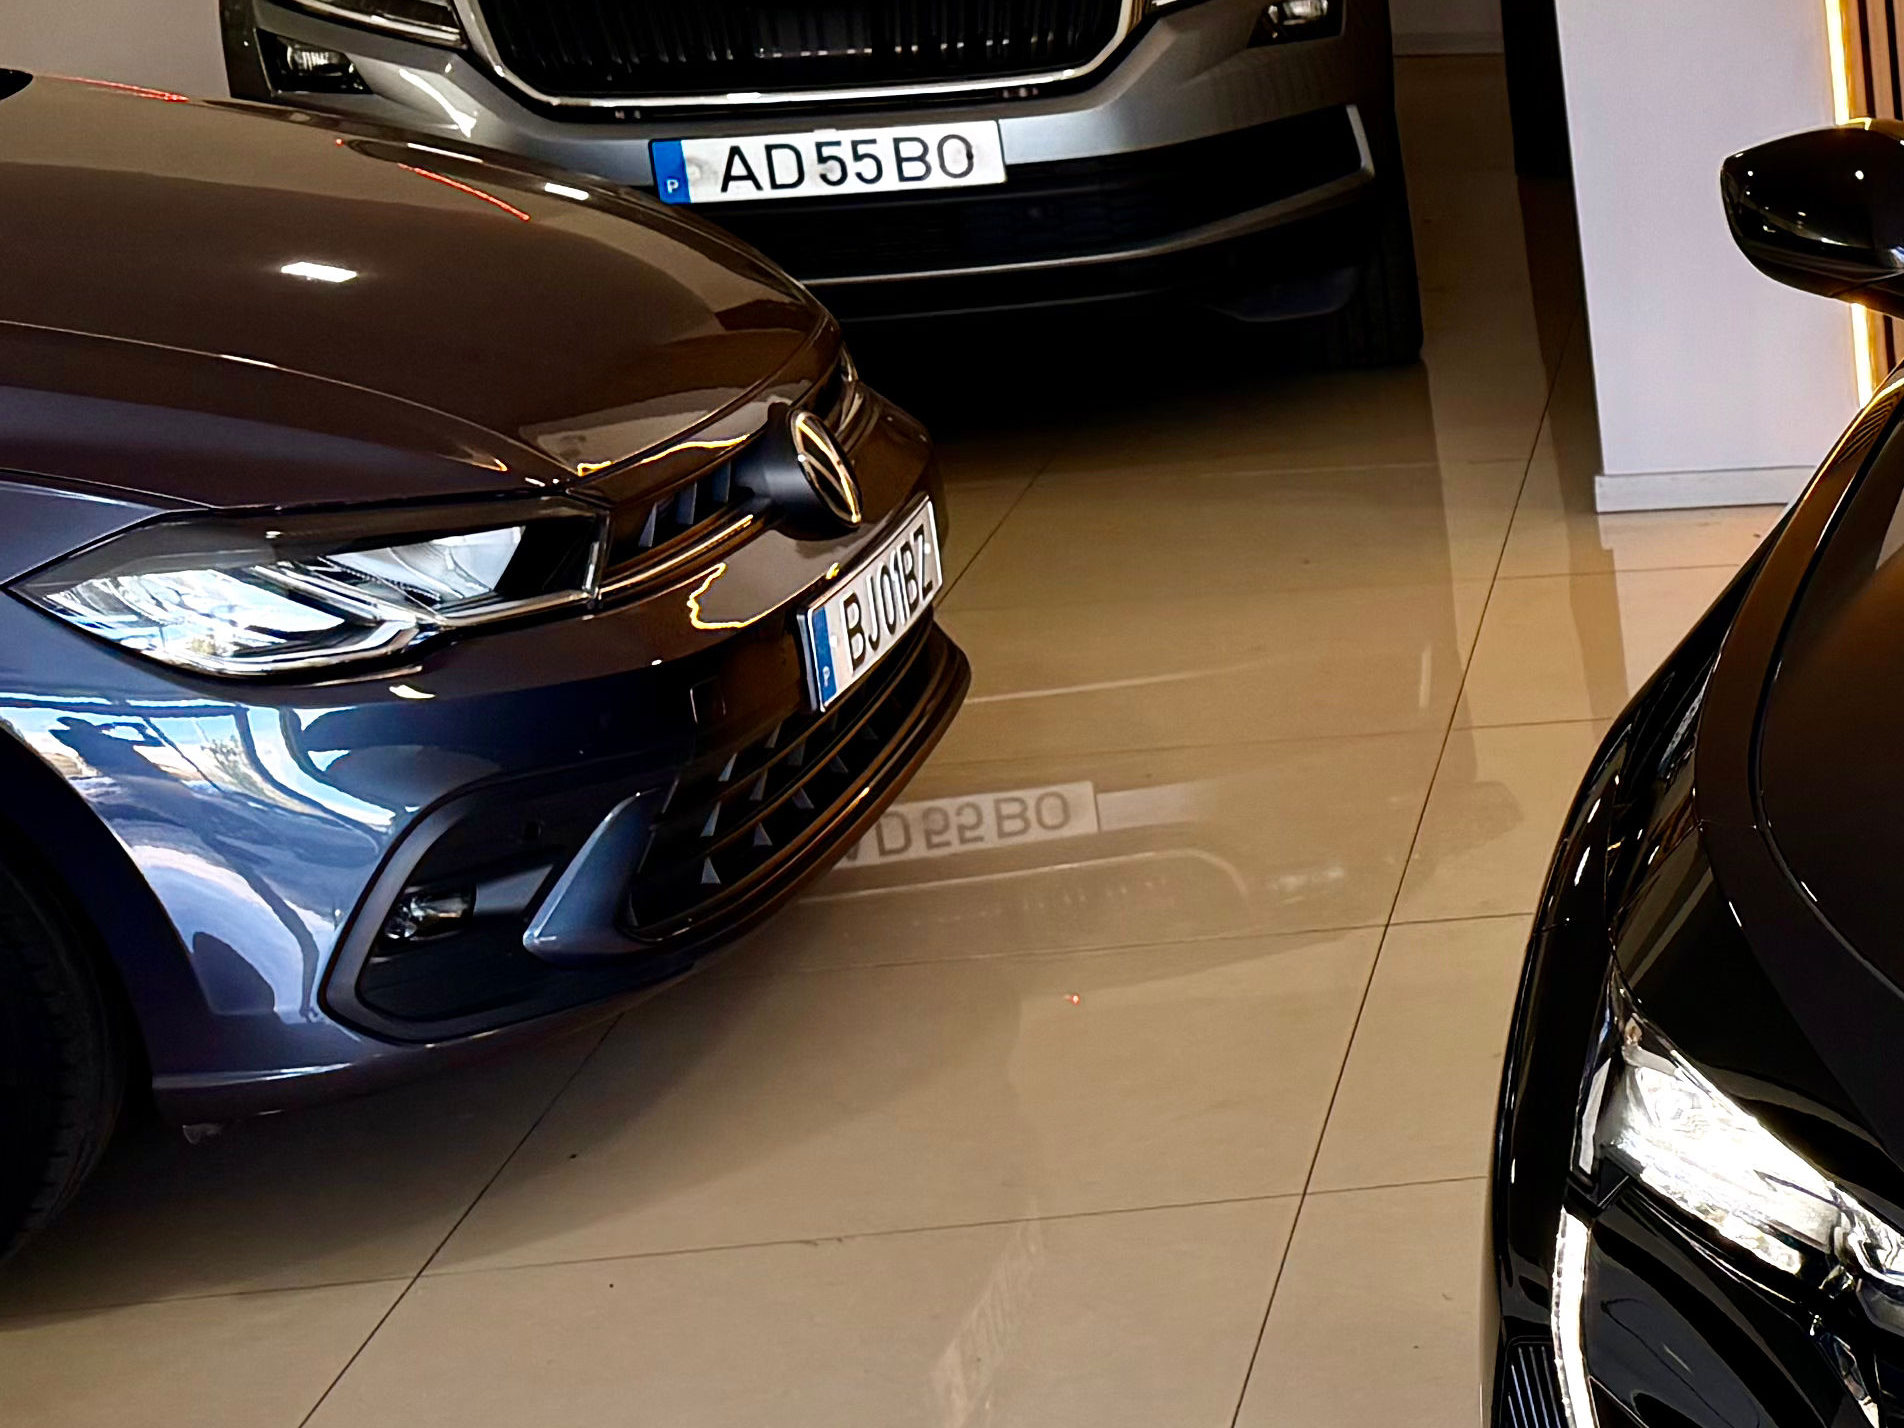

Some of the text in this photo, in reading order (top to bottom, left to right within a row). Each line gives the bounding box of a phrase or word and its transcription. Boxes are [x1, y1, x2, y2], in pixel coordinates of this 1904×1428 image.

[666, 133, 974, 194] P AD55BO
[842, 523, 934, 675] BJ01BZ
